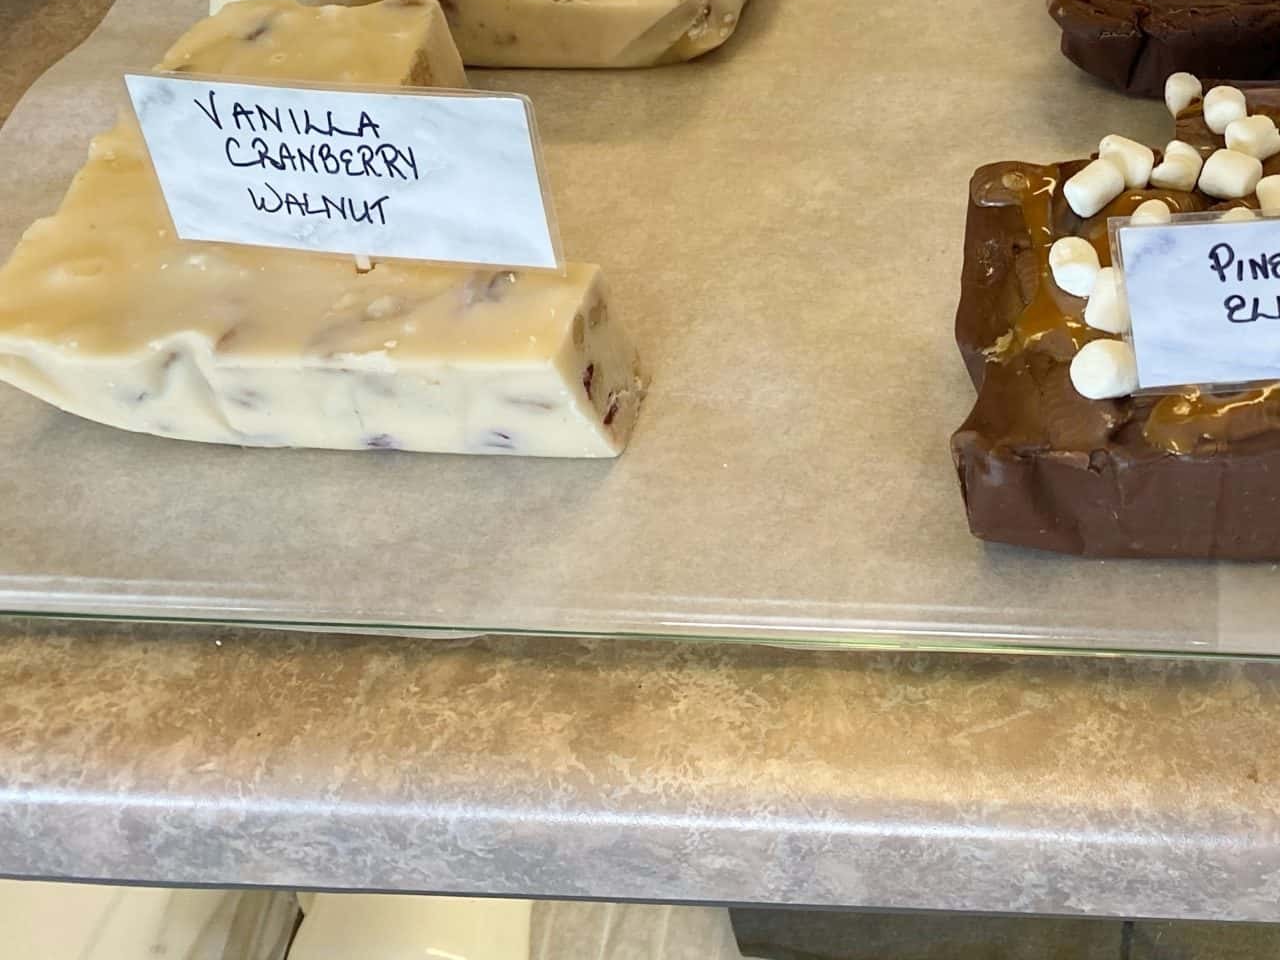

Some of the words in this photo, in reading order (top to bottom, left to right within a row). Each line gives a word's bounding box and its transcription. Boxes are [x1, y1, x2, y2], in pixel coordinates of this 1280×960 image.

[193, 90, 380, 140] VANILLA
[225, 136, 419, 181] CRANBERRY
[247, 182, 390, 225] WALNUT
